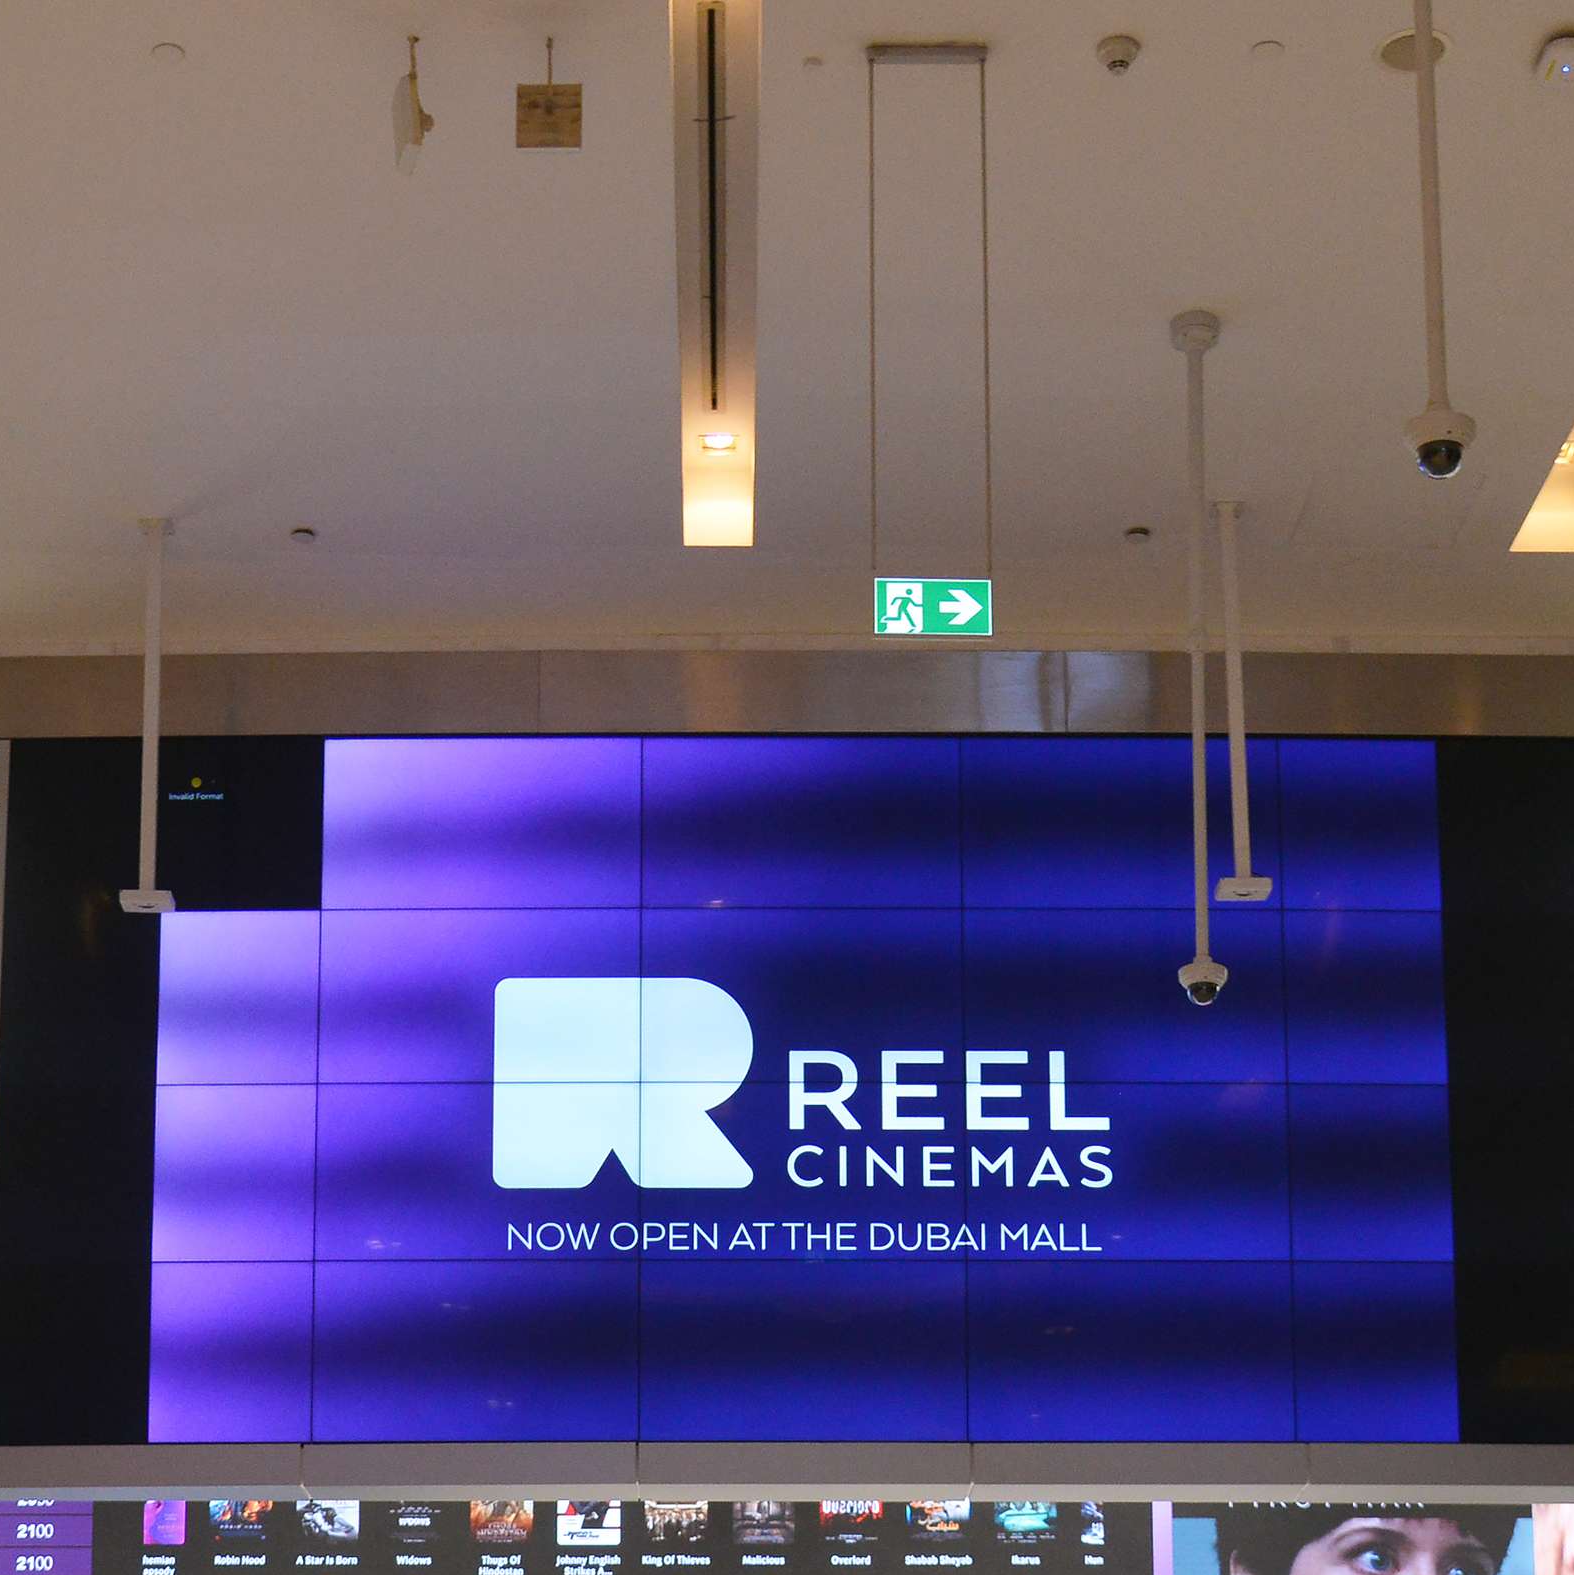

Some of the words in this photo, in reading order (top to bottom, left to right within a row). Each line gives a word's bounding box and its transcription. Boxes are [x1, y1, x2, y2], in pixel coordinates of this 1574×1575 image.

[788, 1050, 1111, 1131] REEL
[786, 1145, 1114, 1188] CINEMAS
[506, 1222, 600, 1252] NOW
[609, 1222, 719, 1252] OPEN
[728, 1223, 774, 1252] AT
[782, 1223, 857, 1252] THE
[869, 1222, 987, 1252] DUBAI
[1000, 1223, 1103, 1252] MALL
[16, 1523, 54, 1539] 2100
[15, 1555, 53, 1571] 2100
[214, 1555, 240, 1566] Robin
[241, 1555, 266, 1566] Hood
[296, 1555, 304, 1566] A
[304, 1555, 324, 1566] Star
[335, 1555, 358, 1566] Born
[396, 1555, 432, 1566] Widows
[481, 1555, 508, 1566] Thugs
[509, 1555, 521, 1565] Of
[555, 1555, 588, 1568] Johnny
[588, 1555, 621, 1567] English
[642, 1555, 662, 1567] King
[663, 1555, 675, 1565] Of
[676, 1555, 711, 1565] Thieves
[742, 1555, 785, 1566] Malicious
[830, 1555, 871, 1566] Overlord
[1011, 1555, 1041, 1566] Ikarus
